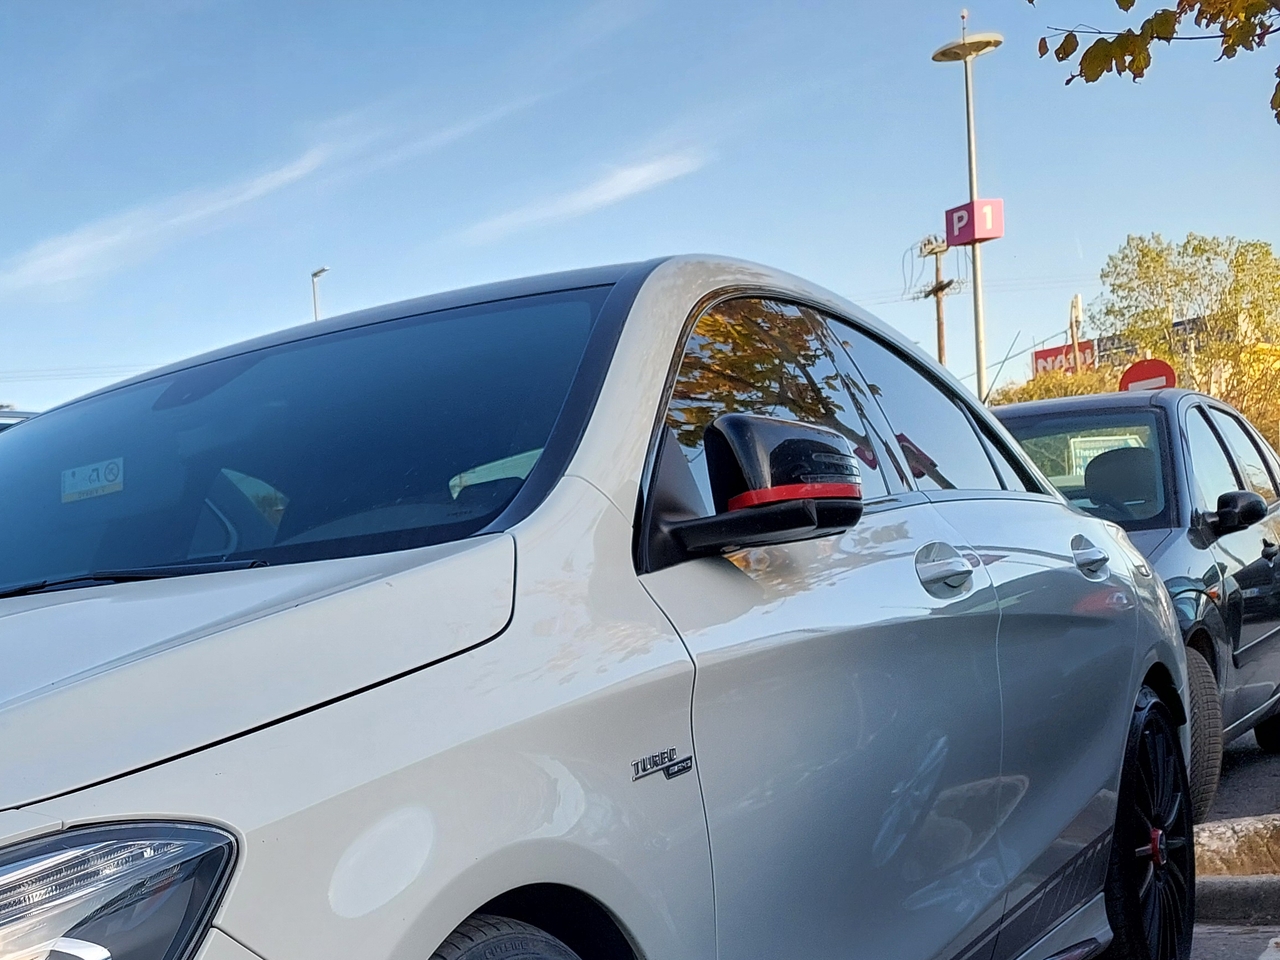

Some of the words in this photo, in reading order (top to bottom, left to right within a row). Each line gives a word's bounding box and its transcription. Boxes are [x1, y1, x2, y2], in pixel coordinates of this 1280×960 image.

[953, 210, 968, 236] P
[982, 204, 992, 230] 1
[631, 746, 677, 776] TURBO
